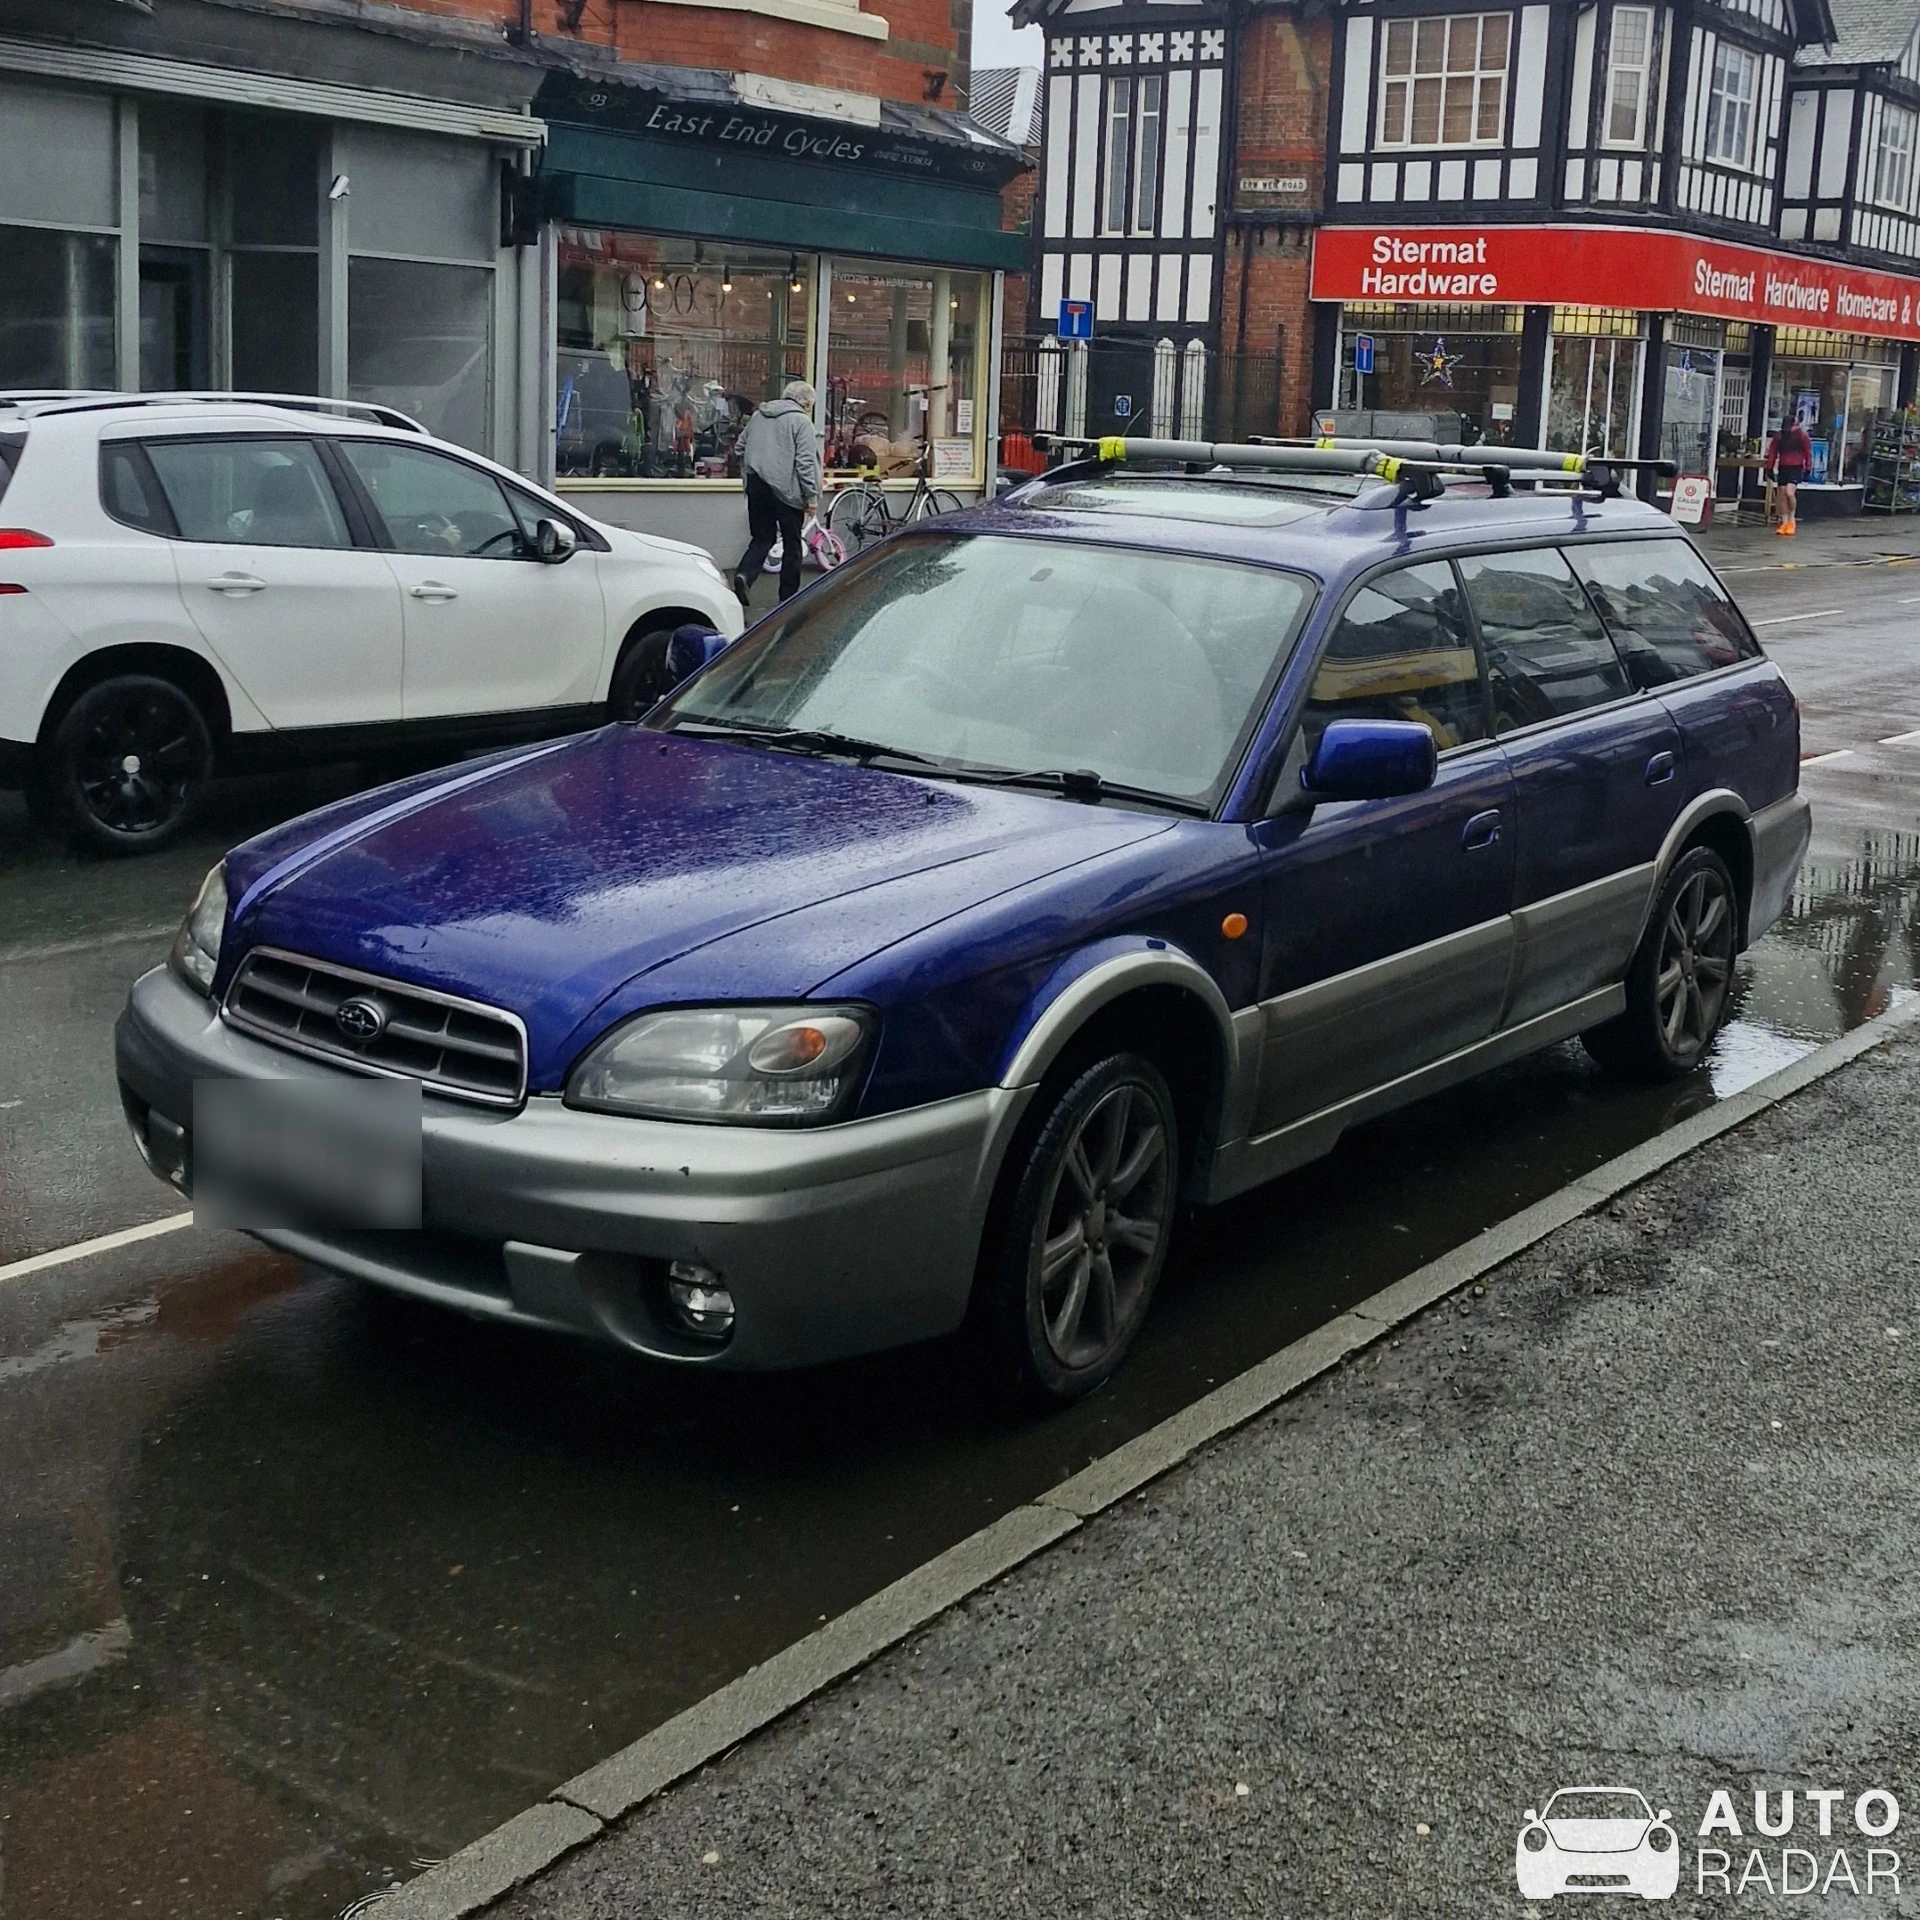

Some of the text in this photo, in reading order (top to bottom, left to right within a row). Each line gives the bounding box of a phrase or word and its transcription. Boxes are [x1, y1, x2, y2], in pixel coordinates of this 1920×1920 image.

[588, 94, 608, 107] 93
[645, 104, 865, 160] East End Cycles
[1242, 181, 1258, 190] ERW
[1282, 181, 1304, 190] ROAD
[1372, 235, 1487, 264] Stermat
[1361, 267, 1498, 296] Hardware
[1694, 258, 1756, 303] Stermat
[1764, 272, 1829, 312] Hardware
[1836, 284, 1897, 322] Homecare
[1901, 295, 1911, 325] &
[1677, 496, 1700, 505] CALOR
